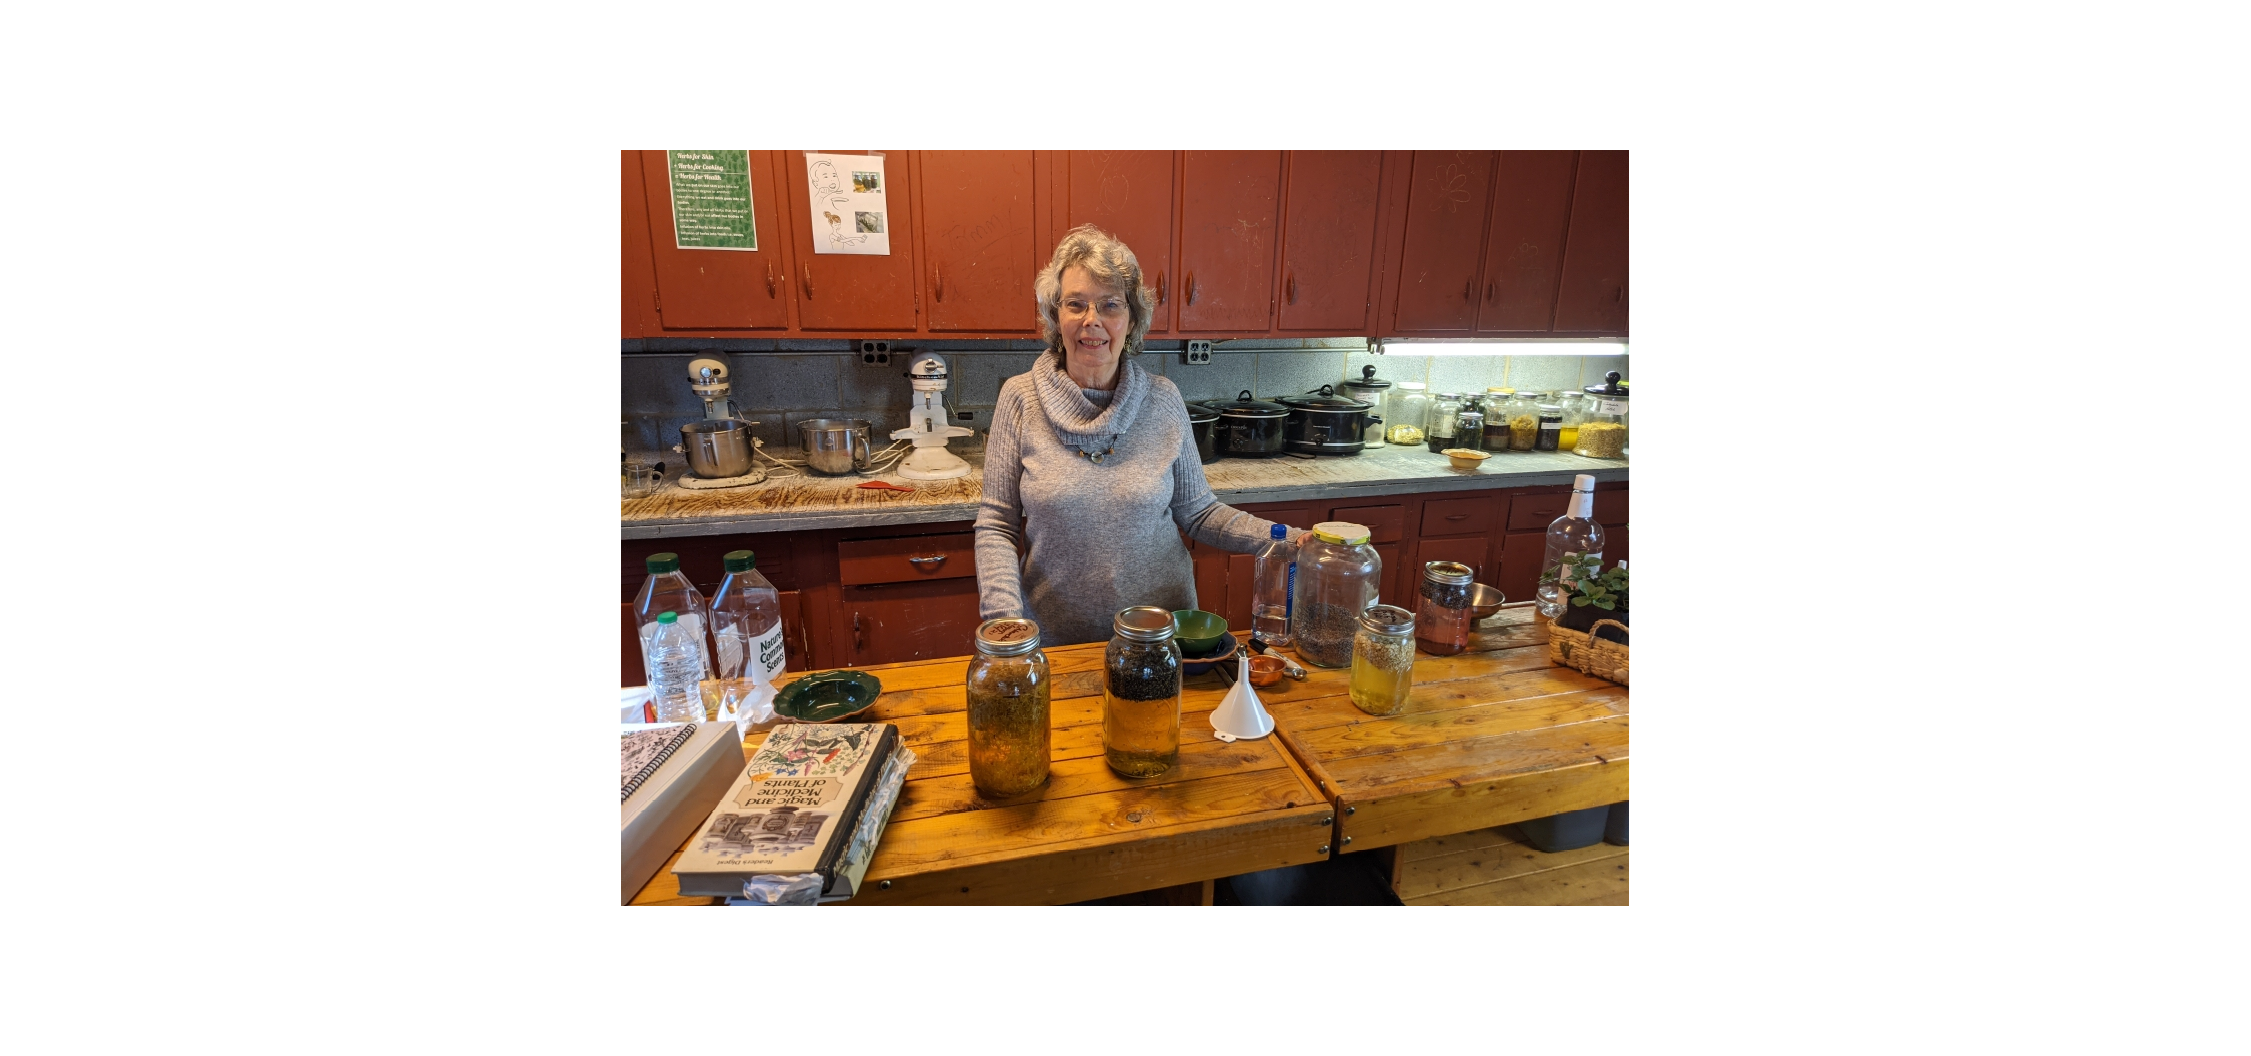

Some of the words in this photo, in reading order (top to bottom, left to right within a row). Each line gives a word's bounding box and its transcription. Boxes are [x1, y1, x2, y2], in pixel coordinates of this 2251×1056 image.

[766, 652, 784, 673] Scents
[757, 788, 823, 797] Medicine
[777, 796, 822, 806] Magic
